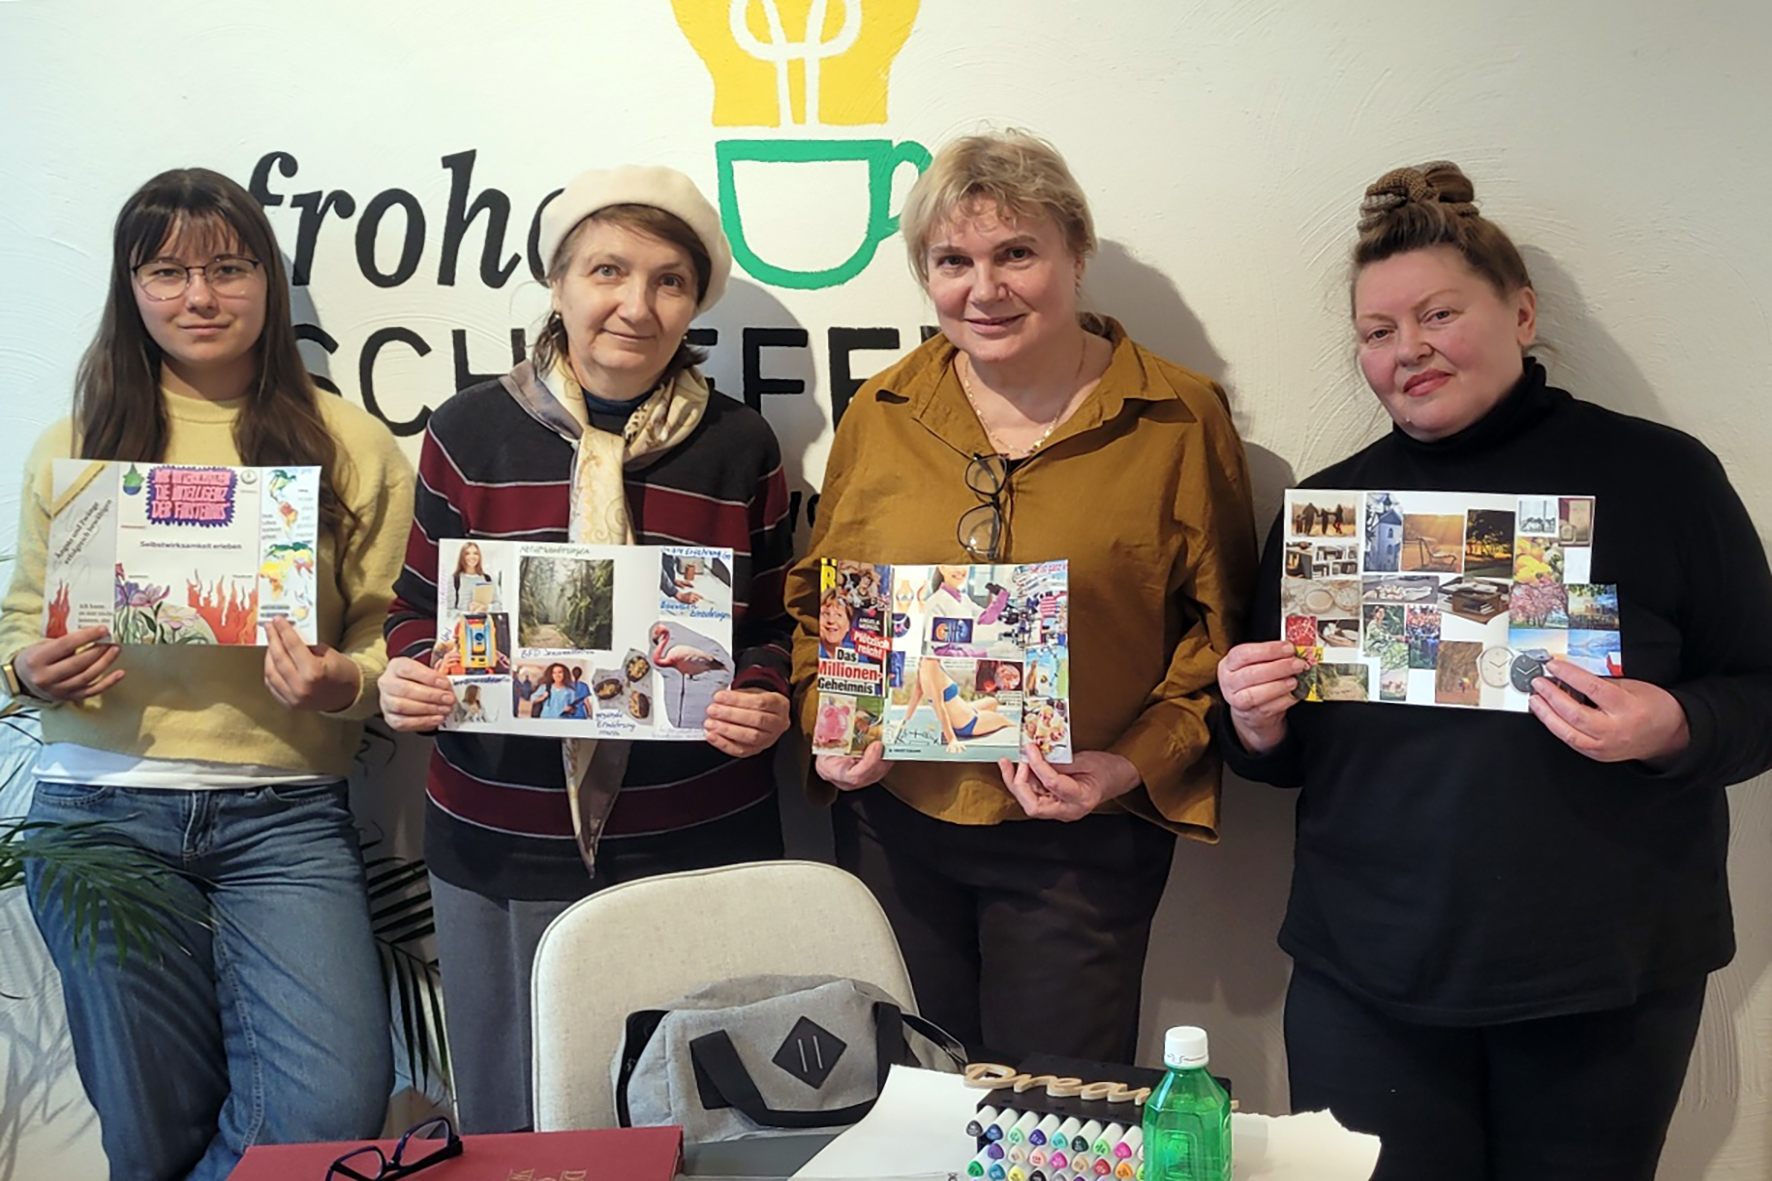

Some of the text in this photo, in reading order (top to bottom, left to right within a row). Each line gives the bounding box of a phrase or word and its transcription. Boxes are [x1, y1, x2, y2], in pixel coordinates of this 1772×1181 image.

[249, 149, 565, 288] froh
[140, 541, 242, 550] Selbstwirksamkeit erleben
[837, 649, 857, 661] Das
[818, 677, 873, 694] Geheimnis
